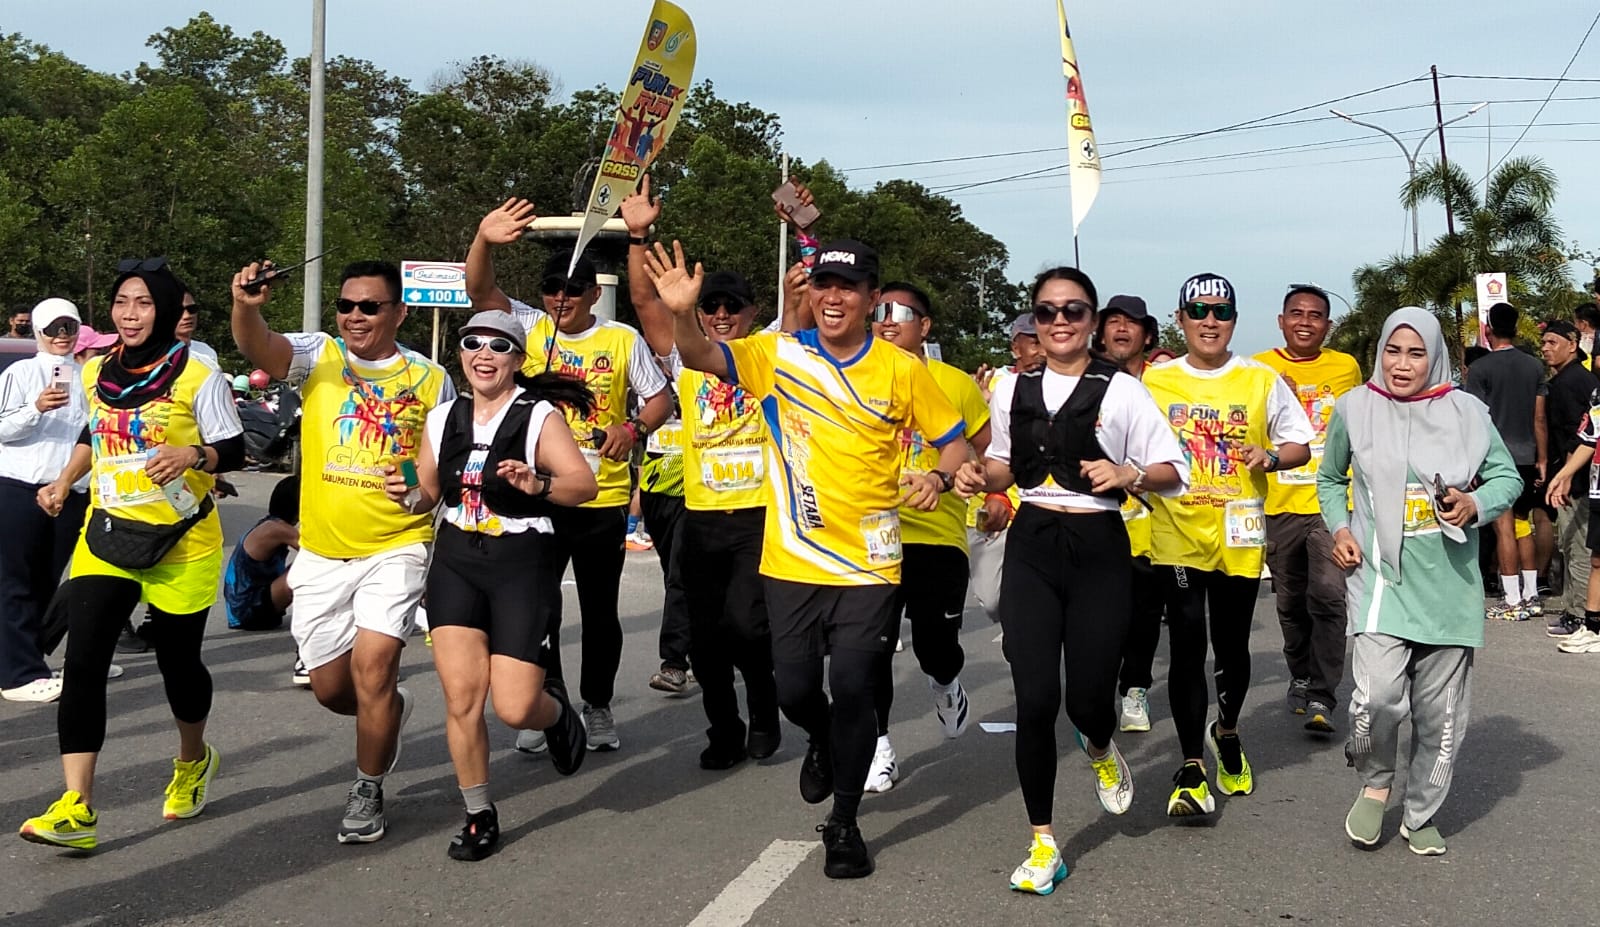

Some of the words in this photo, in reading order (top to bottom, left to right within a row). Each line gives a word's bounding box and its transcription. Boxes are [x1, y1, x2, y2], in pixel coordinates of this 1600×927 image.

[631, 66, 670, 96] FUN
[602, 161, 639, 180] GASS
[819, 250, 855, 265] HOKA
[427, 290, 452, 302] 100
[454, 291, 467, 302] M
[1189, 407, 1220, 420] FUN
[1194, 420, 1225, 436] RUN
[713, 462, 755, 481] 0414
